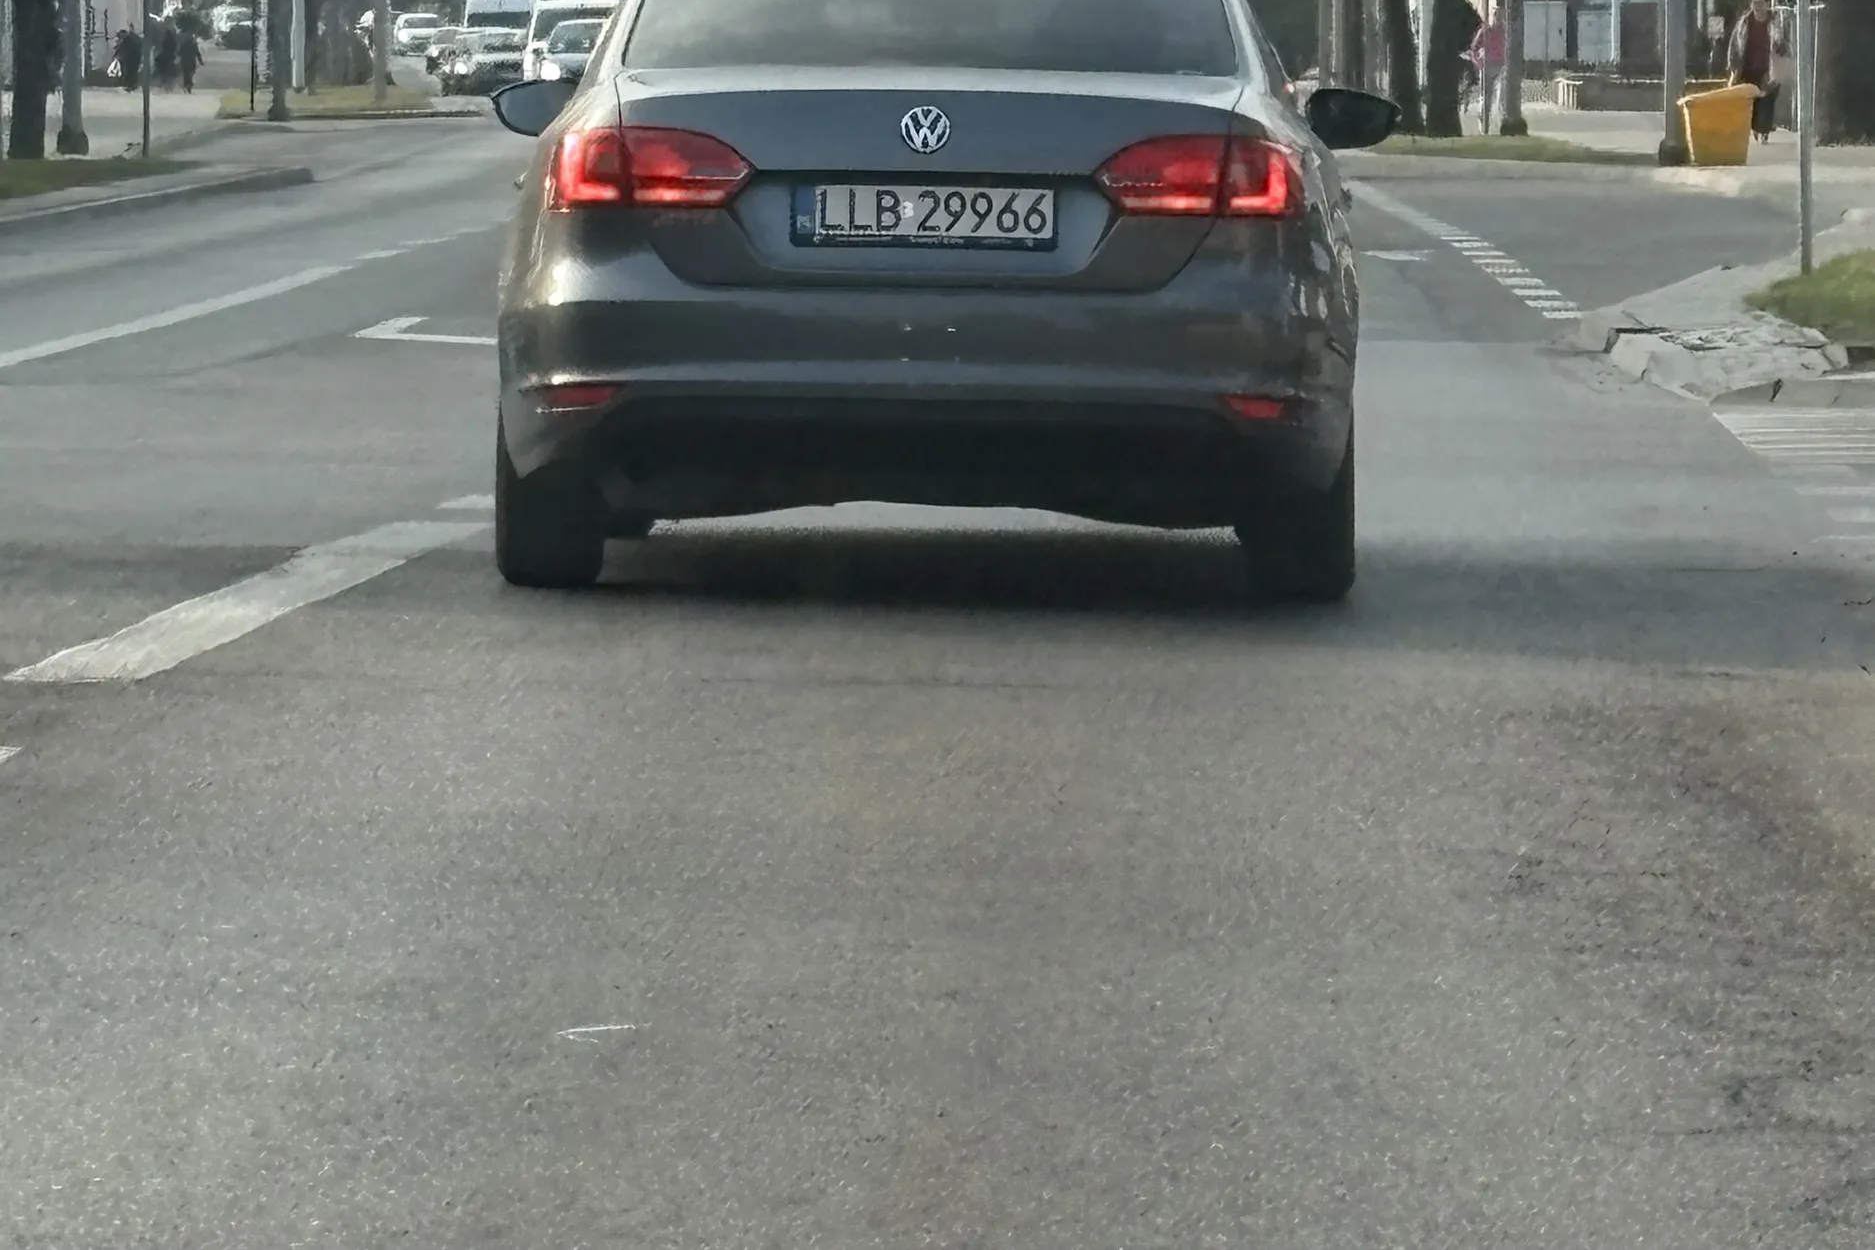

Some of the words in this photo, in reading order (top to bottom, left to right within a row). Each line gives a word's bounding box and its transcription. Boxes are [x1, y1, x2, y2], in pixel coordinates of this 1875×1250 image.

[901, 106, 951, 152] VW
[819, 188, 902, 232] LLB
[917, 190, 1048, 235] 29966
